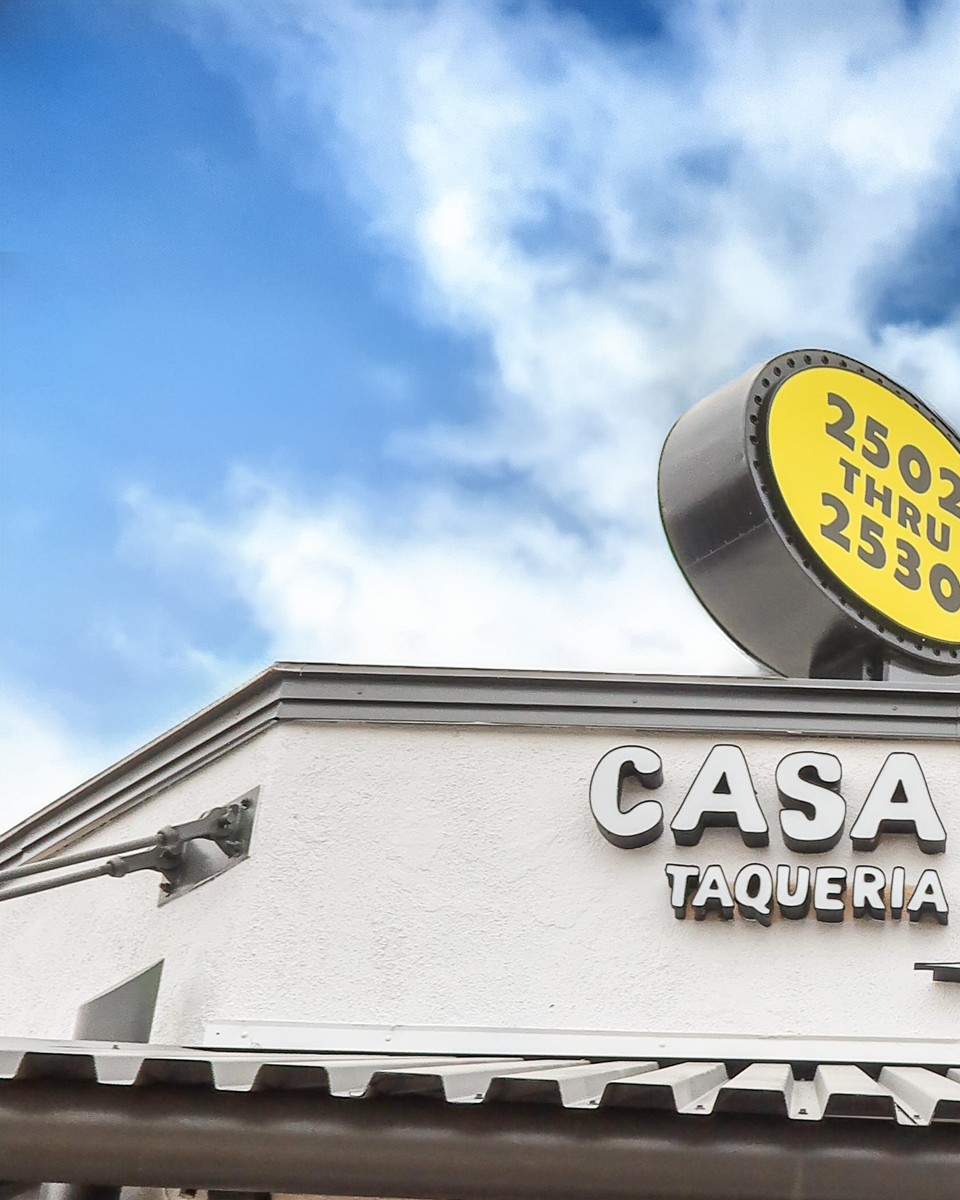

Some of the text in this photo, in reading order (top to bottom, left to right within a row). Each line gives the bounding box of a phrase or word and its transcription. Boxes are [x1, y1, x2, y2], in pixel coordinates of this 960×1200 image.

[839, 458, 951, 552] THRU
[590, 745, 947, 853] CASA
[665, 864, 949, 925] TAQUERIA
